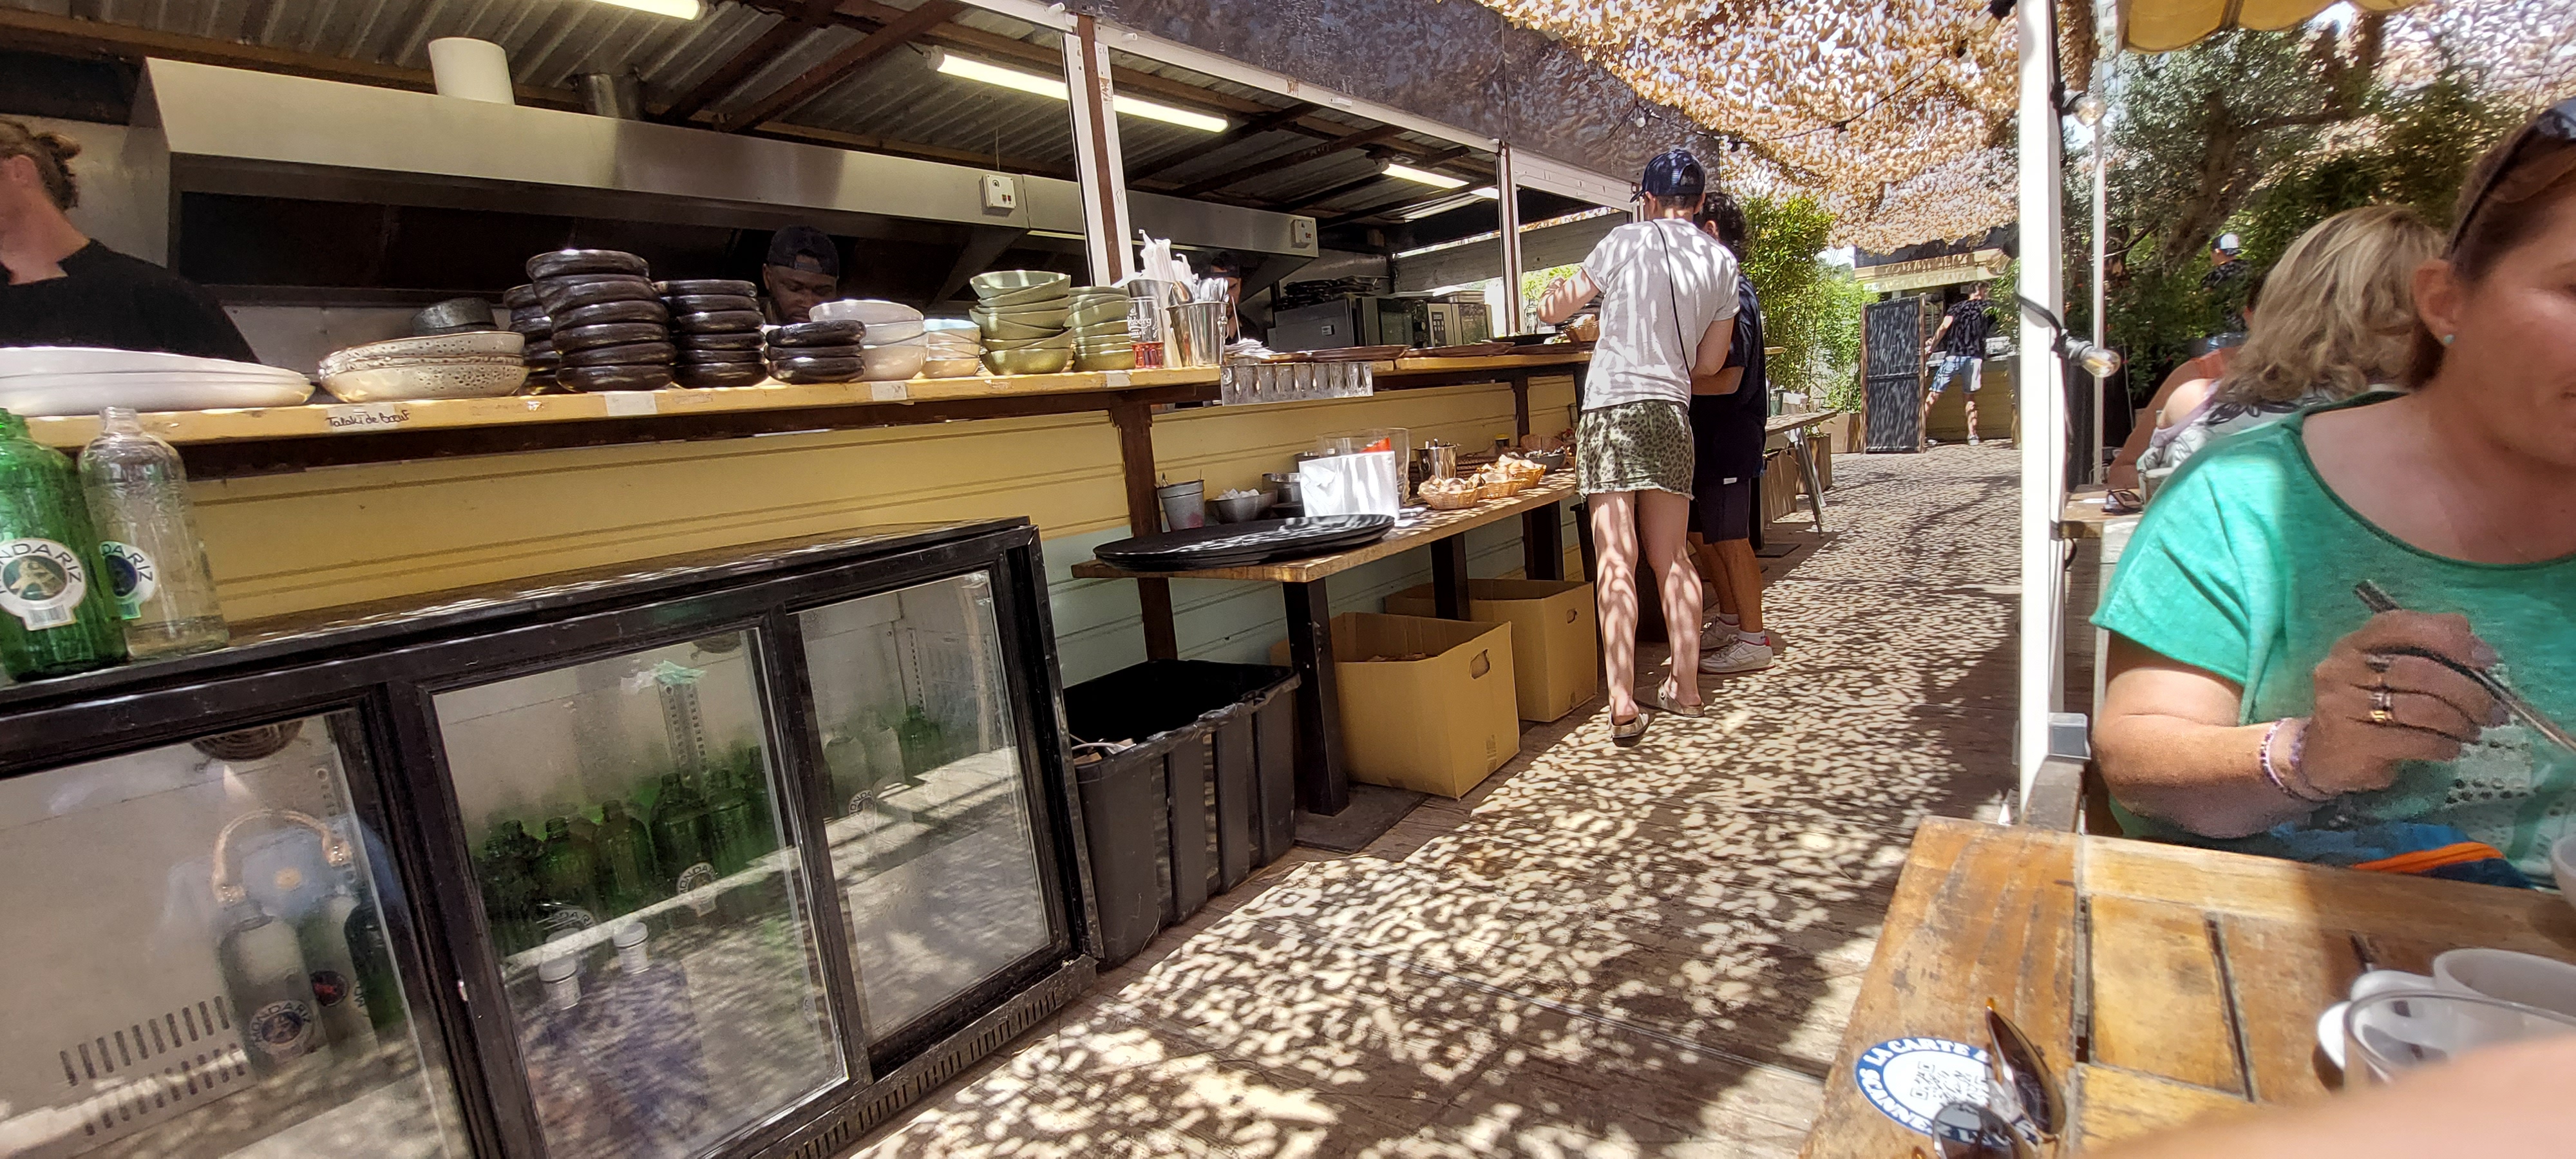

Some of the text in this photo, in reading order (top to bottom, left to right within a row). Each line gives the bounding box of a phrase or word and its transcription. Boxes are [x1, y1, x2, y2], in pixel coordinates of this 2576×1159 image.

[102, 543, 153, 581] DARIZ
[1863, 1038, 1970, 1066] LA CARTE
